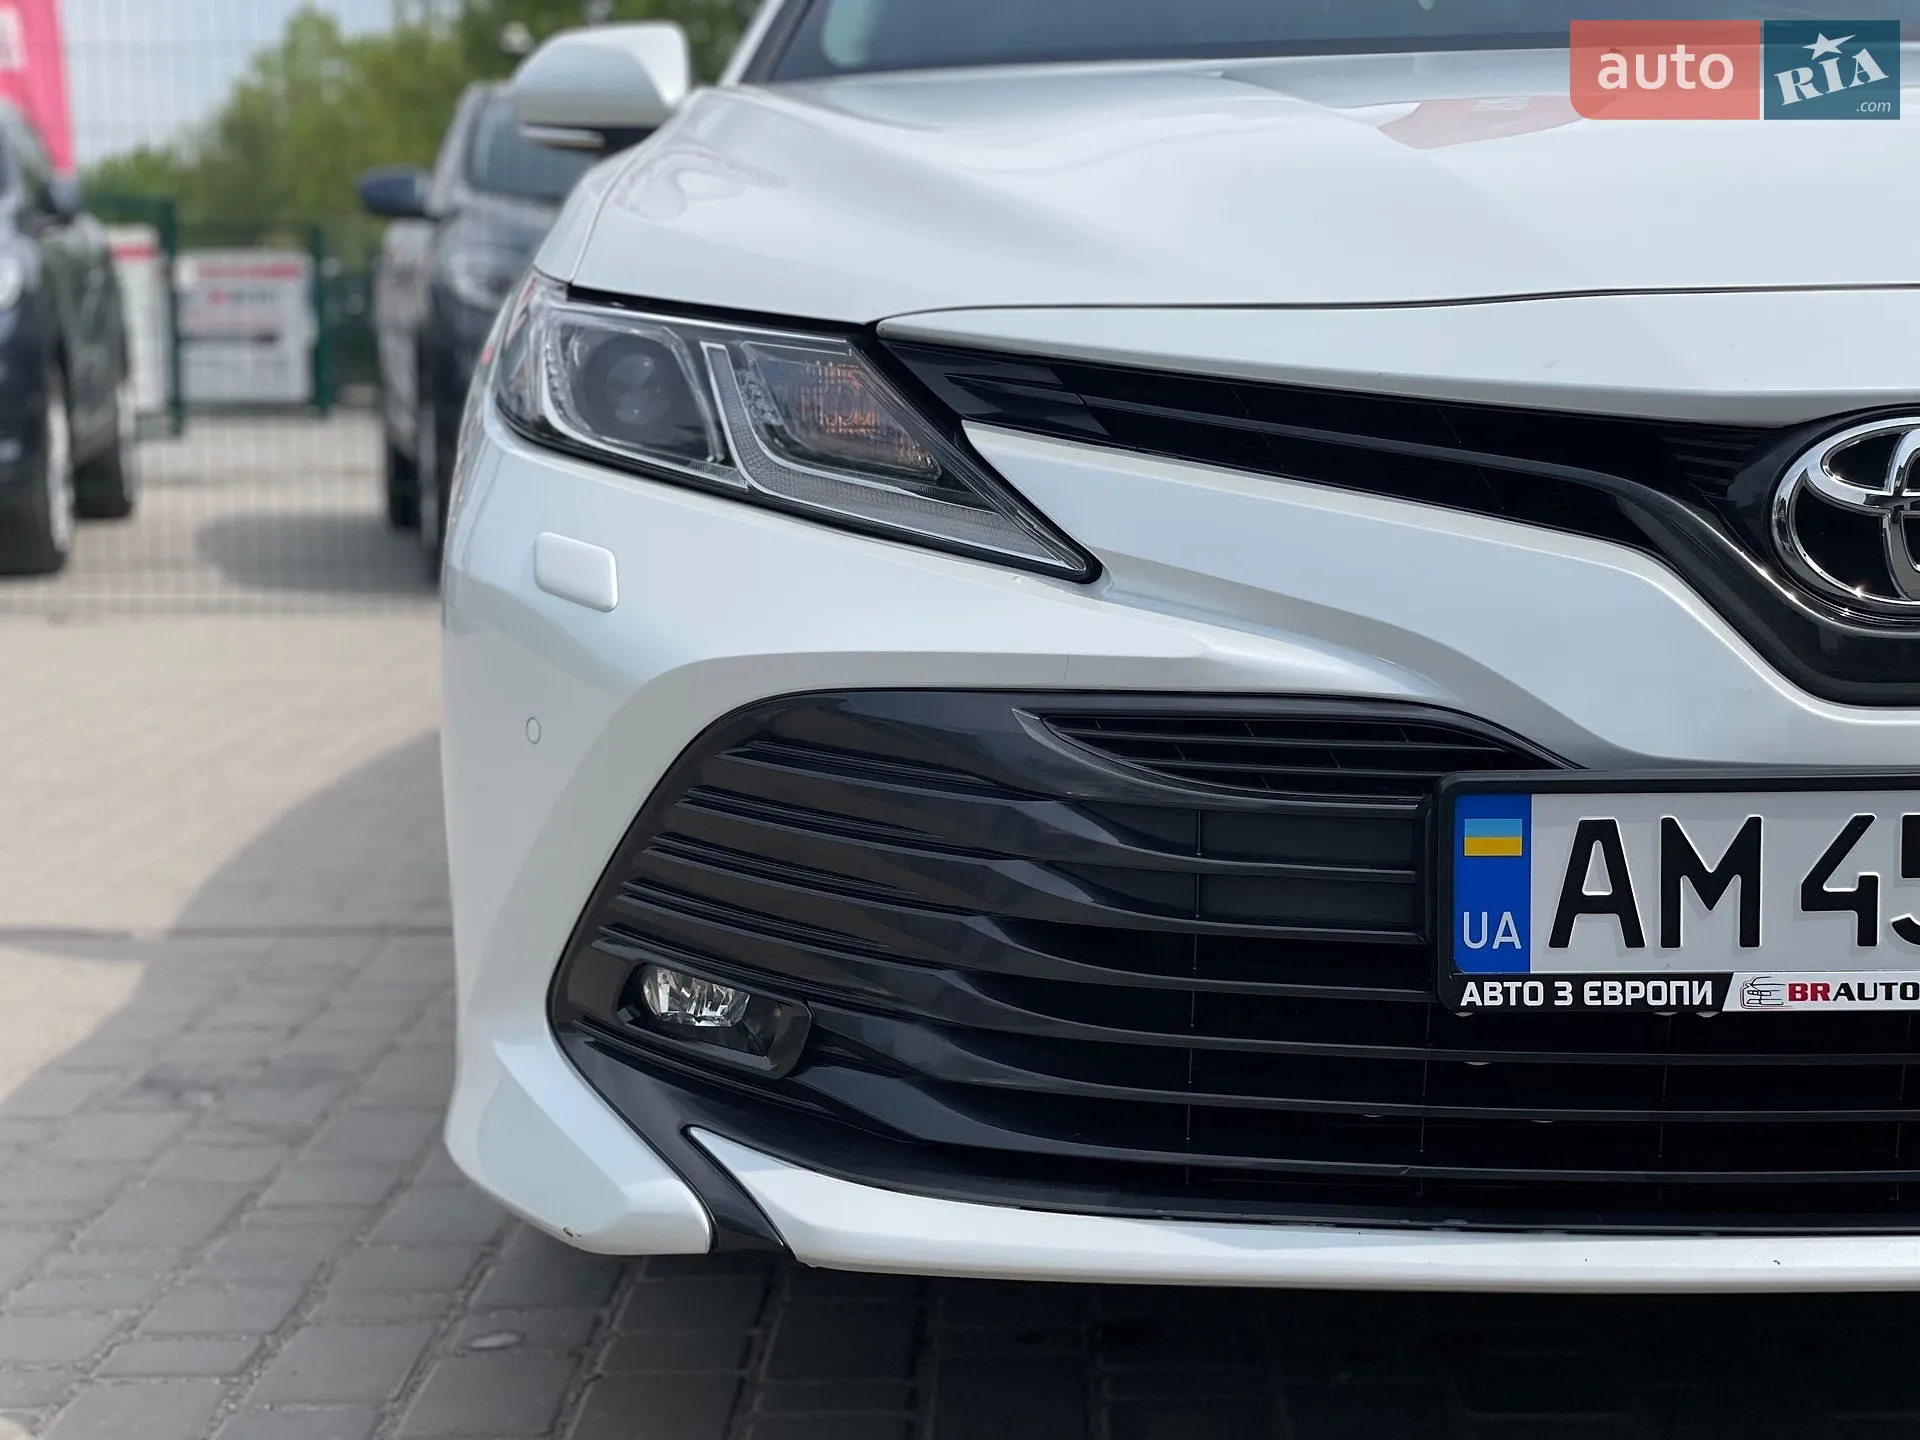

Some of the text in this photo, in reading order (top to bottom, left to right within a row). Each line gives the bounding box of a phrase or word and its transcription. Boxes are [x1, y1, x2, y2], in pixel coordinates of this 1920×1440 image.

[1547, 815, 1764, 949] AM
[1462, 910, 1522, 950] UA
[1460, 981, 1544, 1007] АВТО
[1583, 980, 1713, 1006] ЄВРОПИ
[1788, 982, 1920, 1001] BRAUTO
